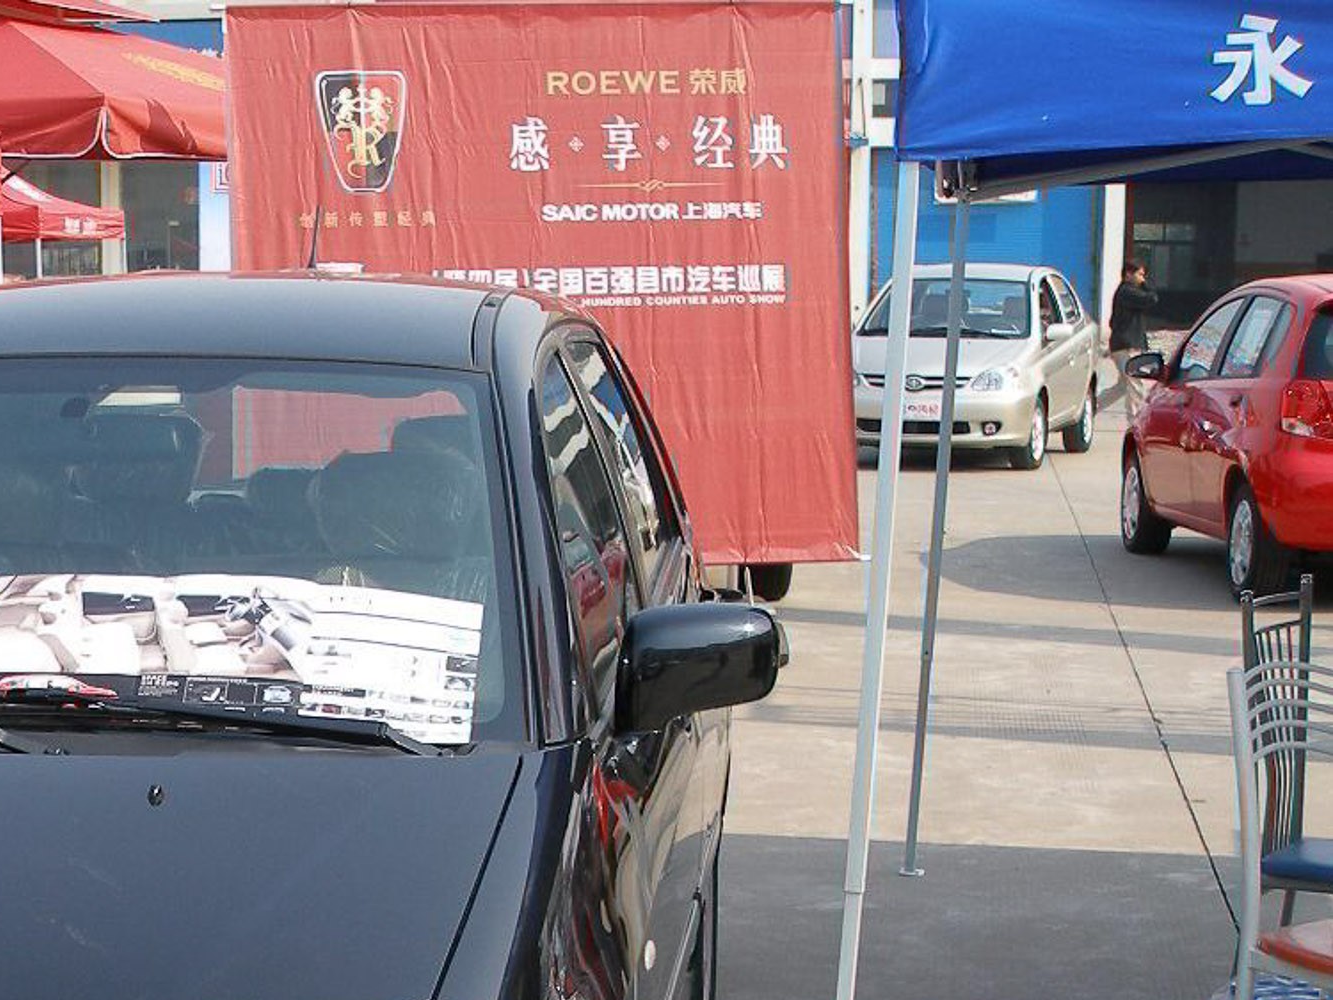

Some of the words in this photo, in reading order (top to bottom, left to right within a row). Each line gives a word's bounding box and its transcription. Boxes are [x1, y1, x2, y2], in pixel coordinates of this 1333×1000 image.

[1210, 13, 1314, 105] 永
[547, 70, 681, 95] ROEWE
[689, 68, 747, 94] 荣威
[542, 204, 597, 222] SAIC
[602, 203, 679, 221] MOTOR
[683, 202, 762, 219] 上海汽车
[582, 295, 642, 307] HUNDRED
[646, 293, 708, 305] COUNTIES
[711, 294, 744, 305] AUTO
[748, 293, 786, 304] SHOW
